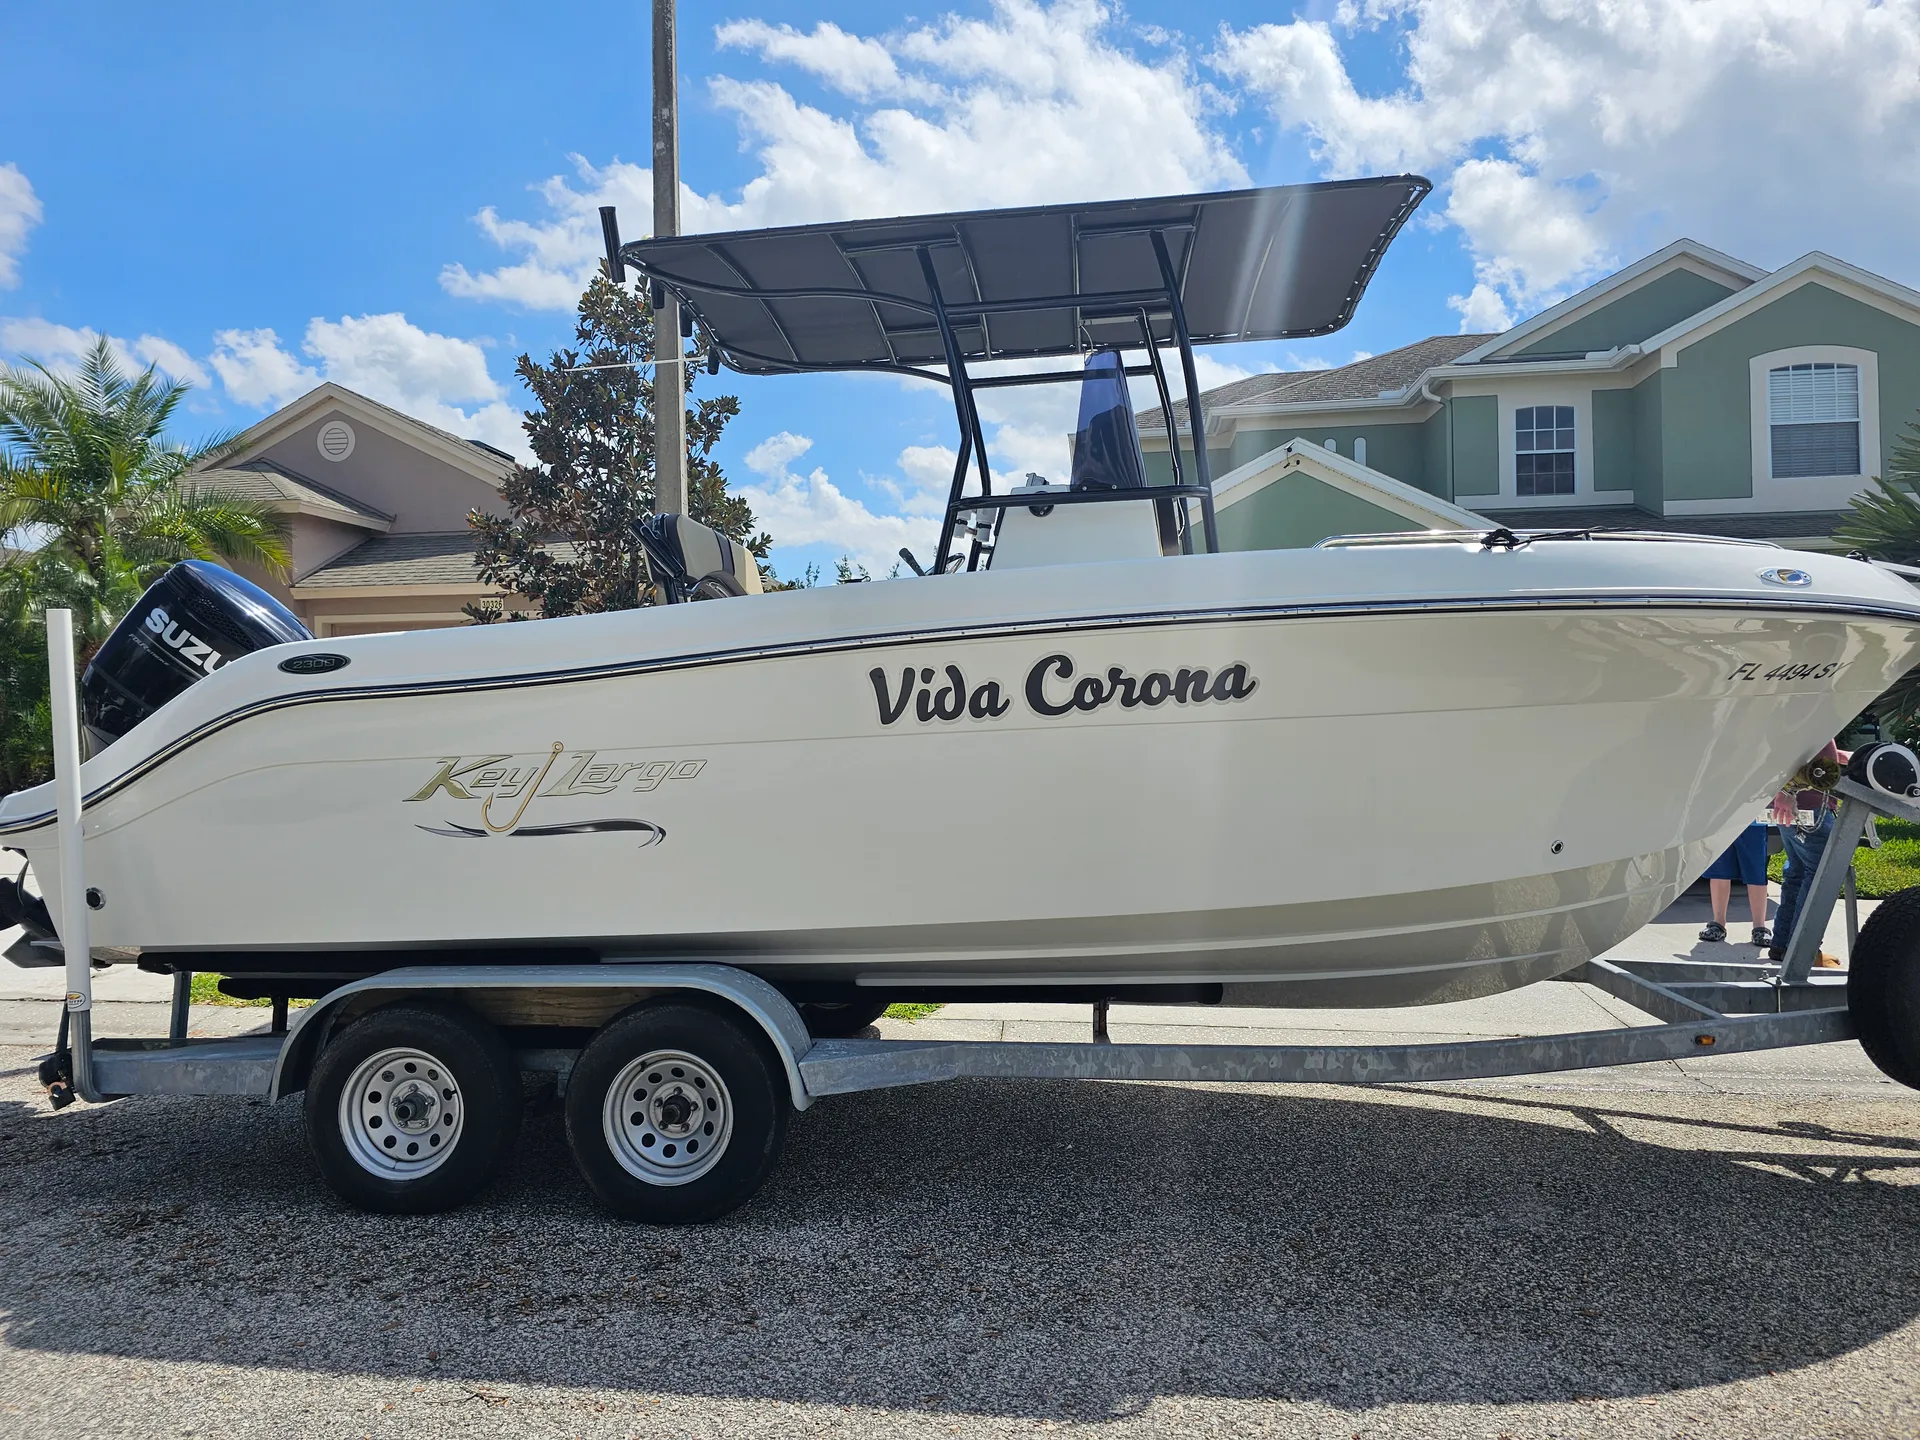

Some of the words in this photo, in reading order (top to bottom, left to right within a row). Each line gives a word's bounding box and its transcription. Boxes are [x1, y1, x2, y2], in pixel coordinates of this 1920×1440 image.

[145, 607, 233, 674] SUZU
[868, 664, 1011, 725] Vida
[1024, 654, 1257, 717] Corona
[1728, 662, 1763, 680] FL
[1763, 663, 1821, 681] 4494
[402, 755, 540, 802] Key
[537, 750, 708, 797] Largo
